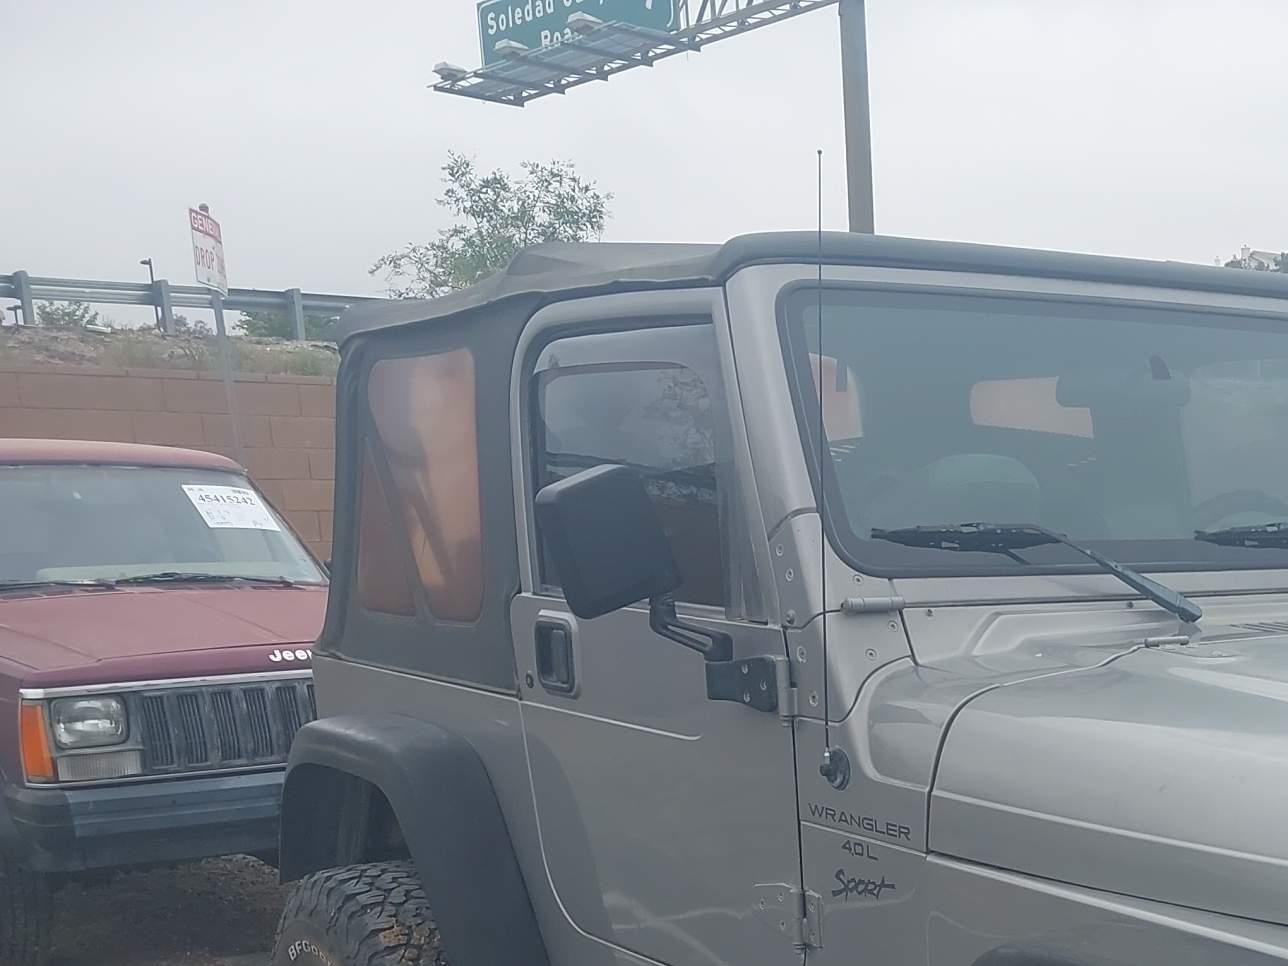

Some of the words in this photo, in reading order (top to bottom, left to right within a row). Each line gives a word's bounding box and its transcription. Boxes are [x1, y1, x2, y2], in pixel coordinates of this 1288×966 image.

[487, 0, 555, 35] Soledad
[541, 27, 583, 48] Roa
[808, 802, 912, 841] WRANGLER
